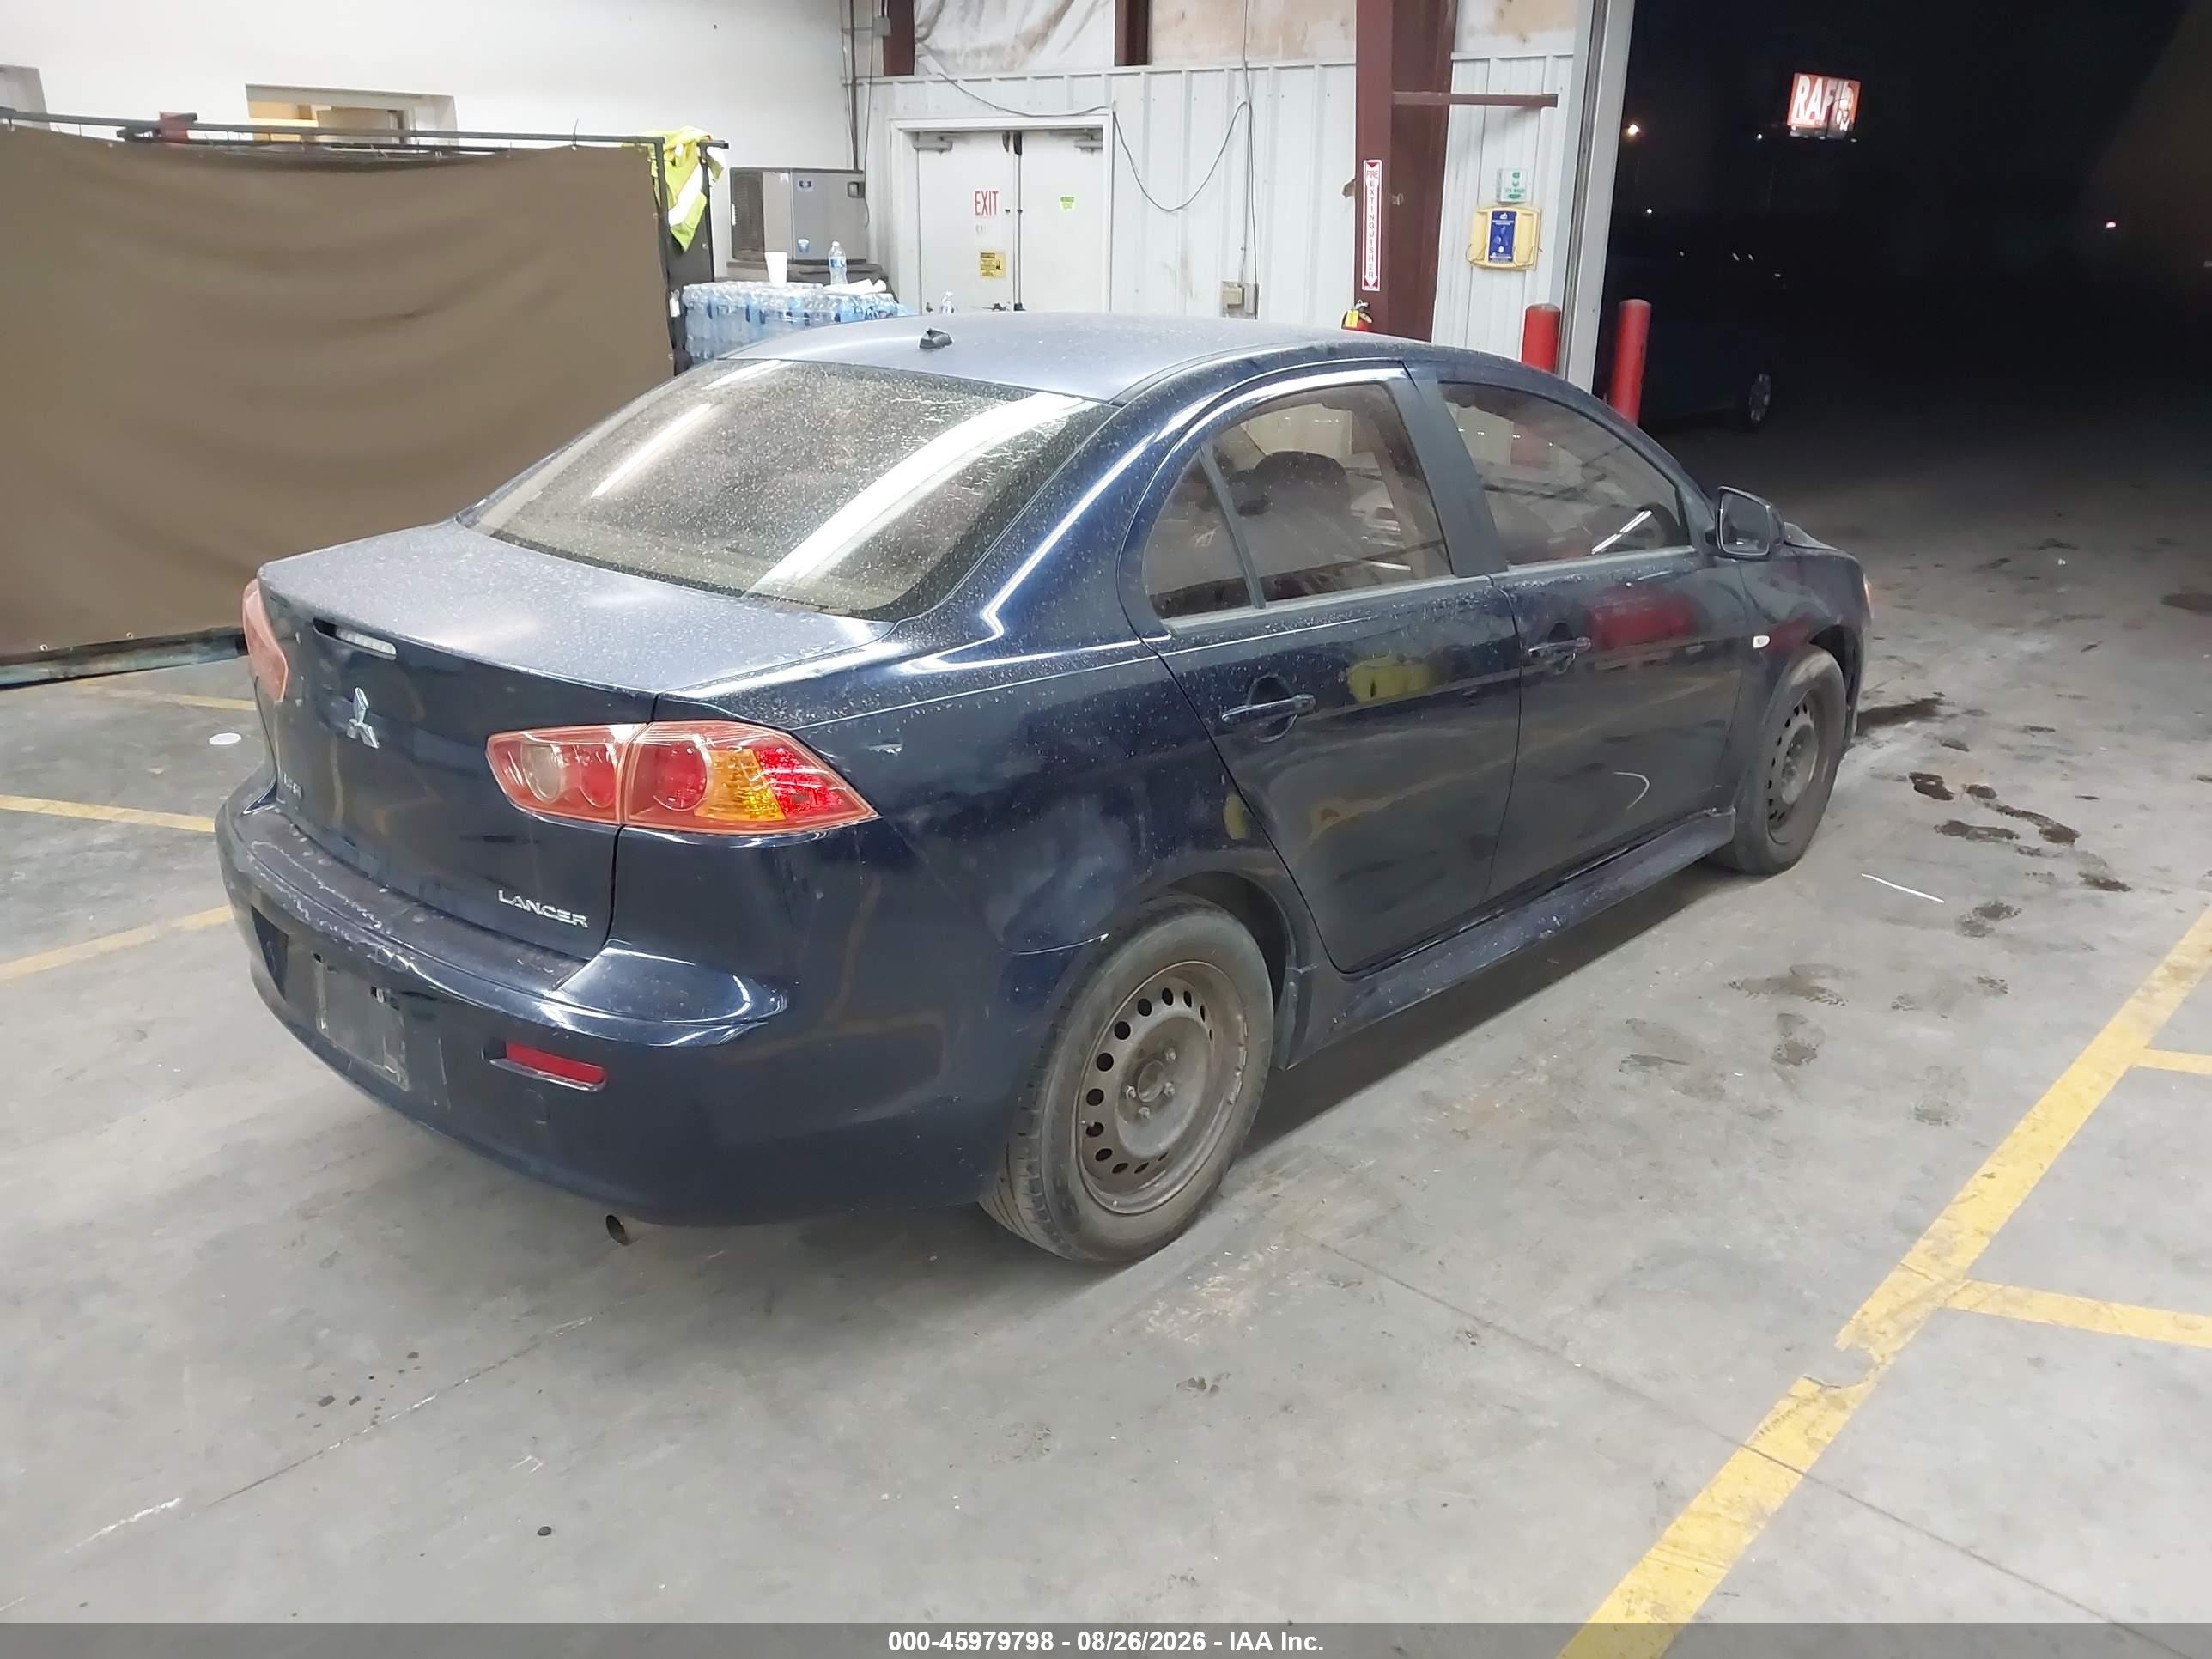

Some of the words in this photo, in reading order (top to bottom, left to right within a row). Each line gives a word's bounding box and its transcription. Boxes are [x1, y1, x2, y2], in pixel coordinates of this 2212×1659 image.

[1367, 170, 1378, 179] FIRE
[975, 190, 999, 216] EXIT
[498, 890, 588, 928] LANCER
